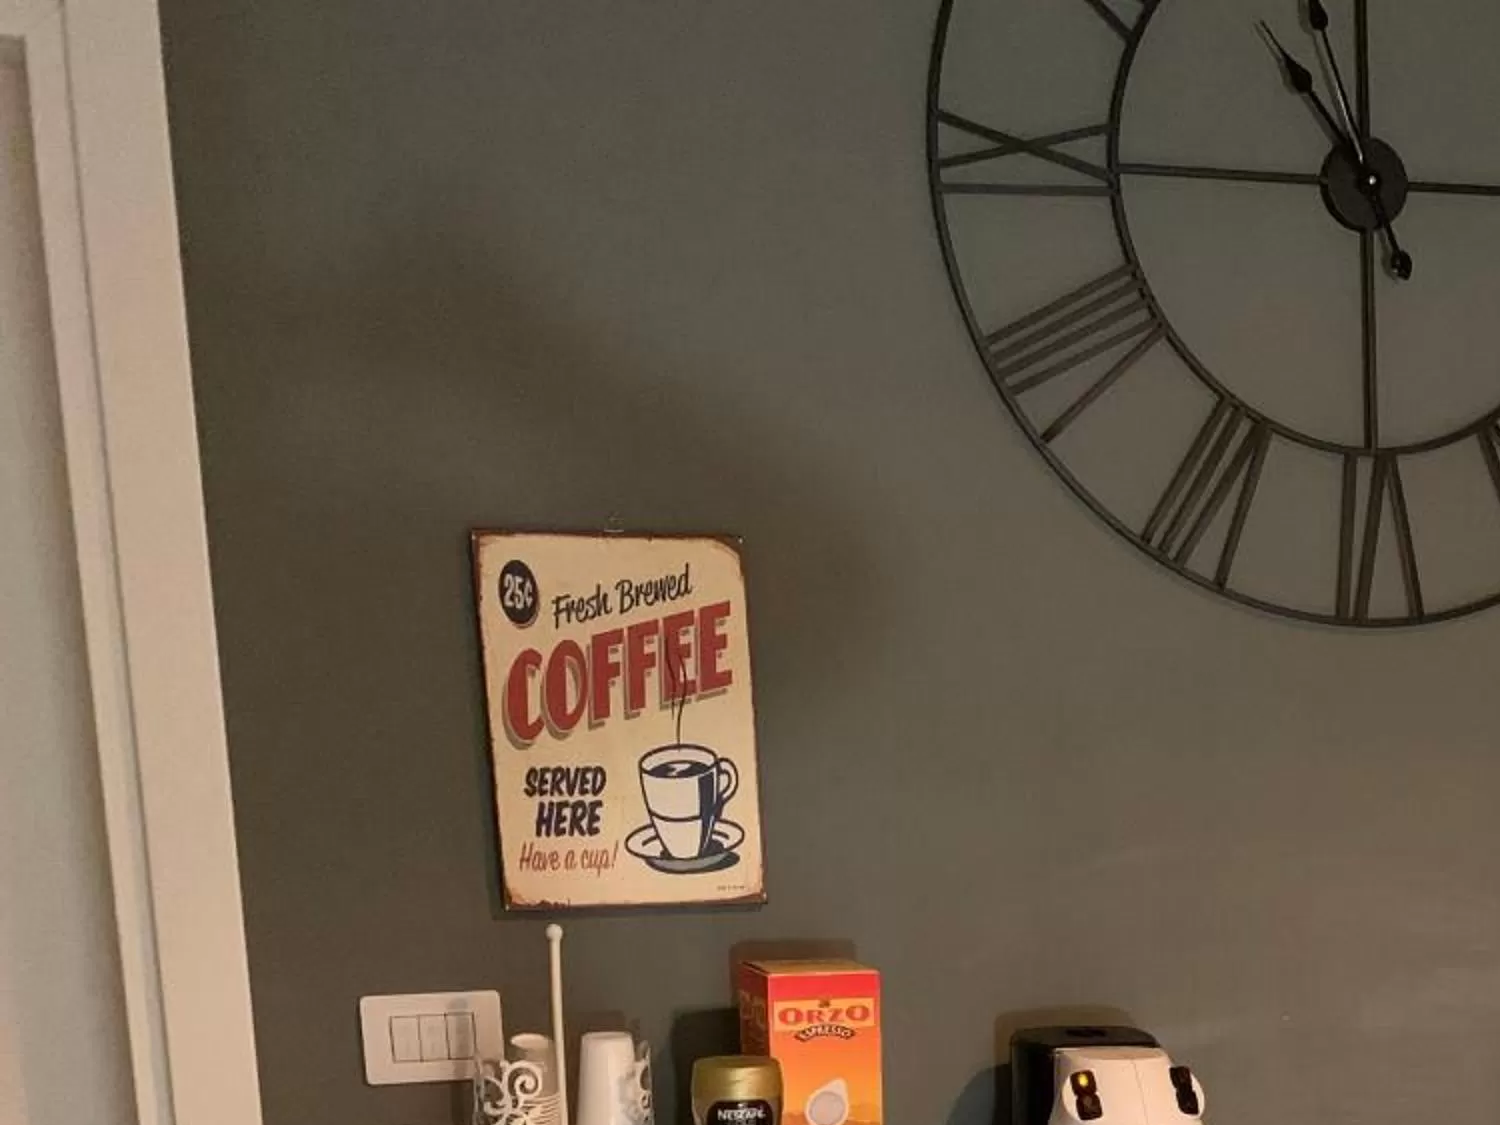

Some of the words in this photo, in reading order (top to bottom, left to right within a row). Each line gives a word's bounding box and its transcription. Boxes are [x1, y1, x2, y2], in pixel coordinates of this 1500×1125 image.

[551, 586, 613, 629] Fresh
[614, 562, 693, 615] Brewed
[504, 600, 733, 747] COFFEE
[523, 766, 607, 798] SERVED
[535, 799, 604, 838] HERE
[518, 841, 561, 872] Have
[564, 846, 578, 869] a
[580, 840, 618, 879] cup!
[778, 1005, 870, 1026] ORZO
